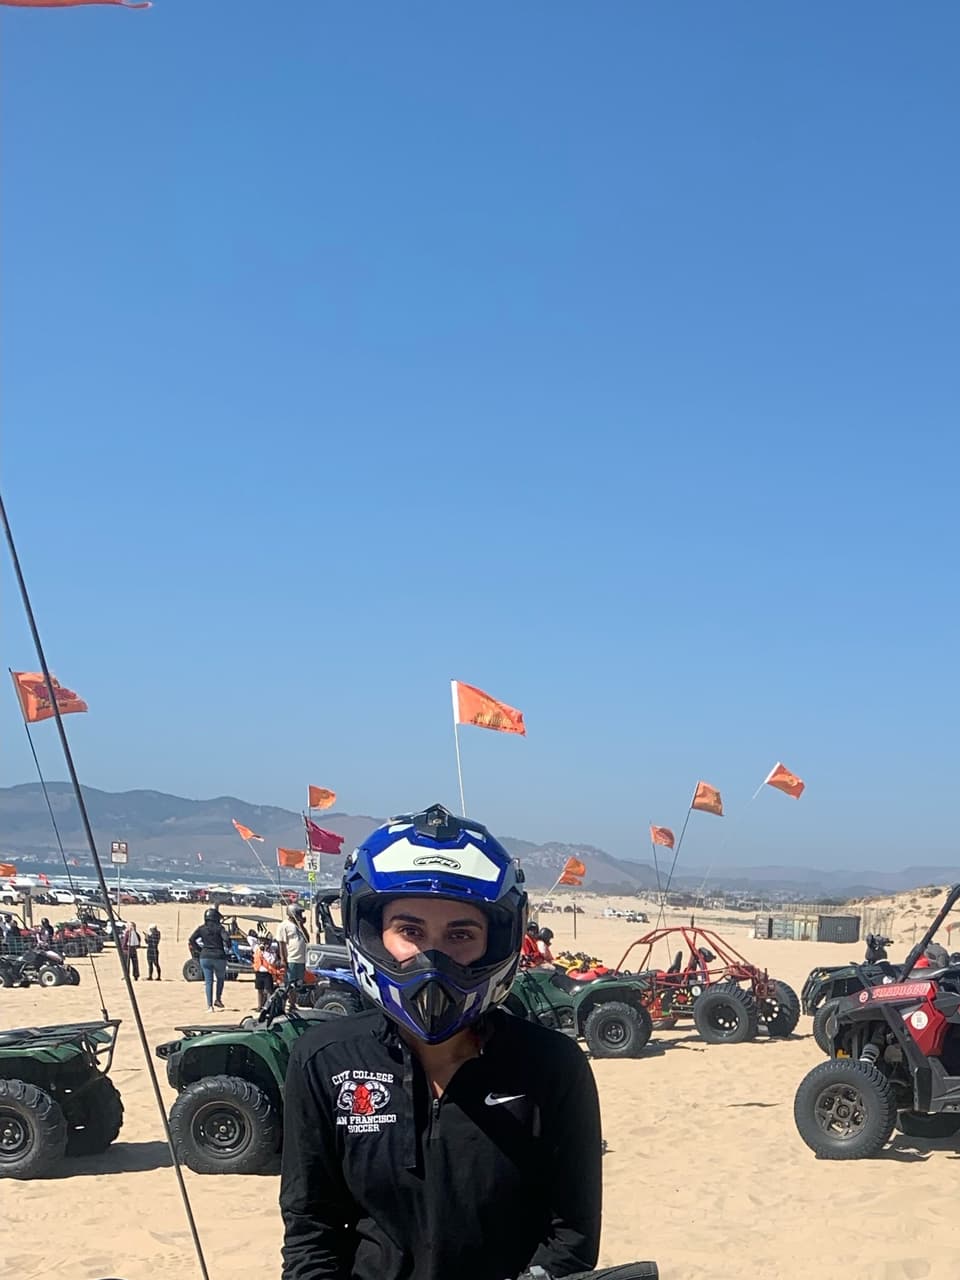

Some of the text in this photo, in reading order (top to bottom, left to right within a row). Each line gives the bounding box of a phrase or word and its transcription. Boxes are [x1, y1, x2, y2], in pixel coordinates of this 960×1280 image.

[352, 1070, 394, 1083] COLLEGE
[336, 1114, 397, 1125] AN FRANCISCO
[347, 1123, 380, 1133] SOCCER
